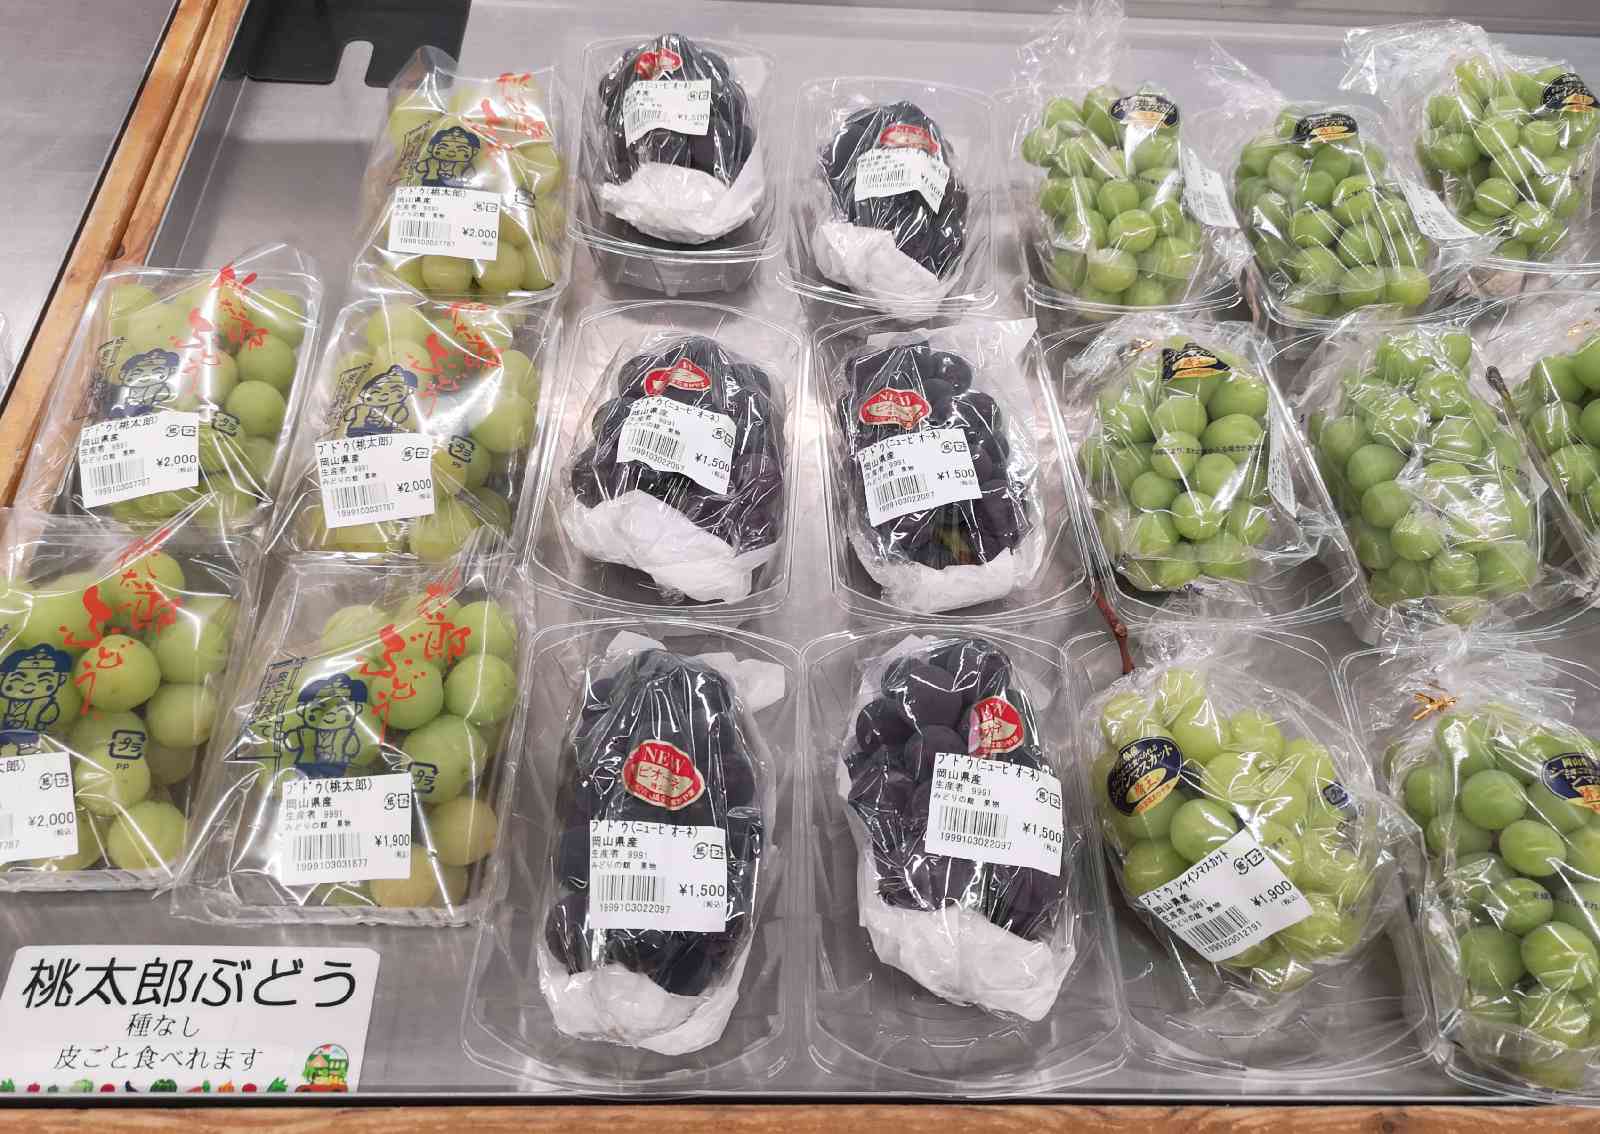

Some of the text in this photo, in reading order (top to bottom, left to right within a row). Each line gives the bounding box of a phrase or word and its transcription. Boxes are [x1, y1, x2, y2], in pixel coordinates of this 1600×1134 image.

[462, 227, 496, 238] ¥2,000
[156, 455, 197, 467] ¥2,000
[695, 453, 729, 472] ¥1,500
[937, 469, 975, 481] ¥1,500
[397, 478, 431, 492] ¥2,000
[936, 768, 981, 785] 岡山県産
[287, 778, 373, 794] ブドウ(桃太郎)
[935, 780, 964, 791] 生産者
[28, 812, 73, 827] ¥2,000
[1022, 822, 1062, 843] ¥1,500
[375, 834, 409, 848] ¥1,900
[592, 836, 638, 848] 岡山県産
[679, 884, 725, 897] ¥1,500
[1250, 881, 1292, 907] ¥1,900
[22, 957, 357, 1008] 桃太郎ぶどう
[126, 1012, 200, 1038] 種なし
[53, 1045, 265, 1071] 皮ごと食べれます
